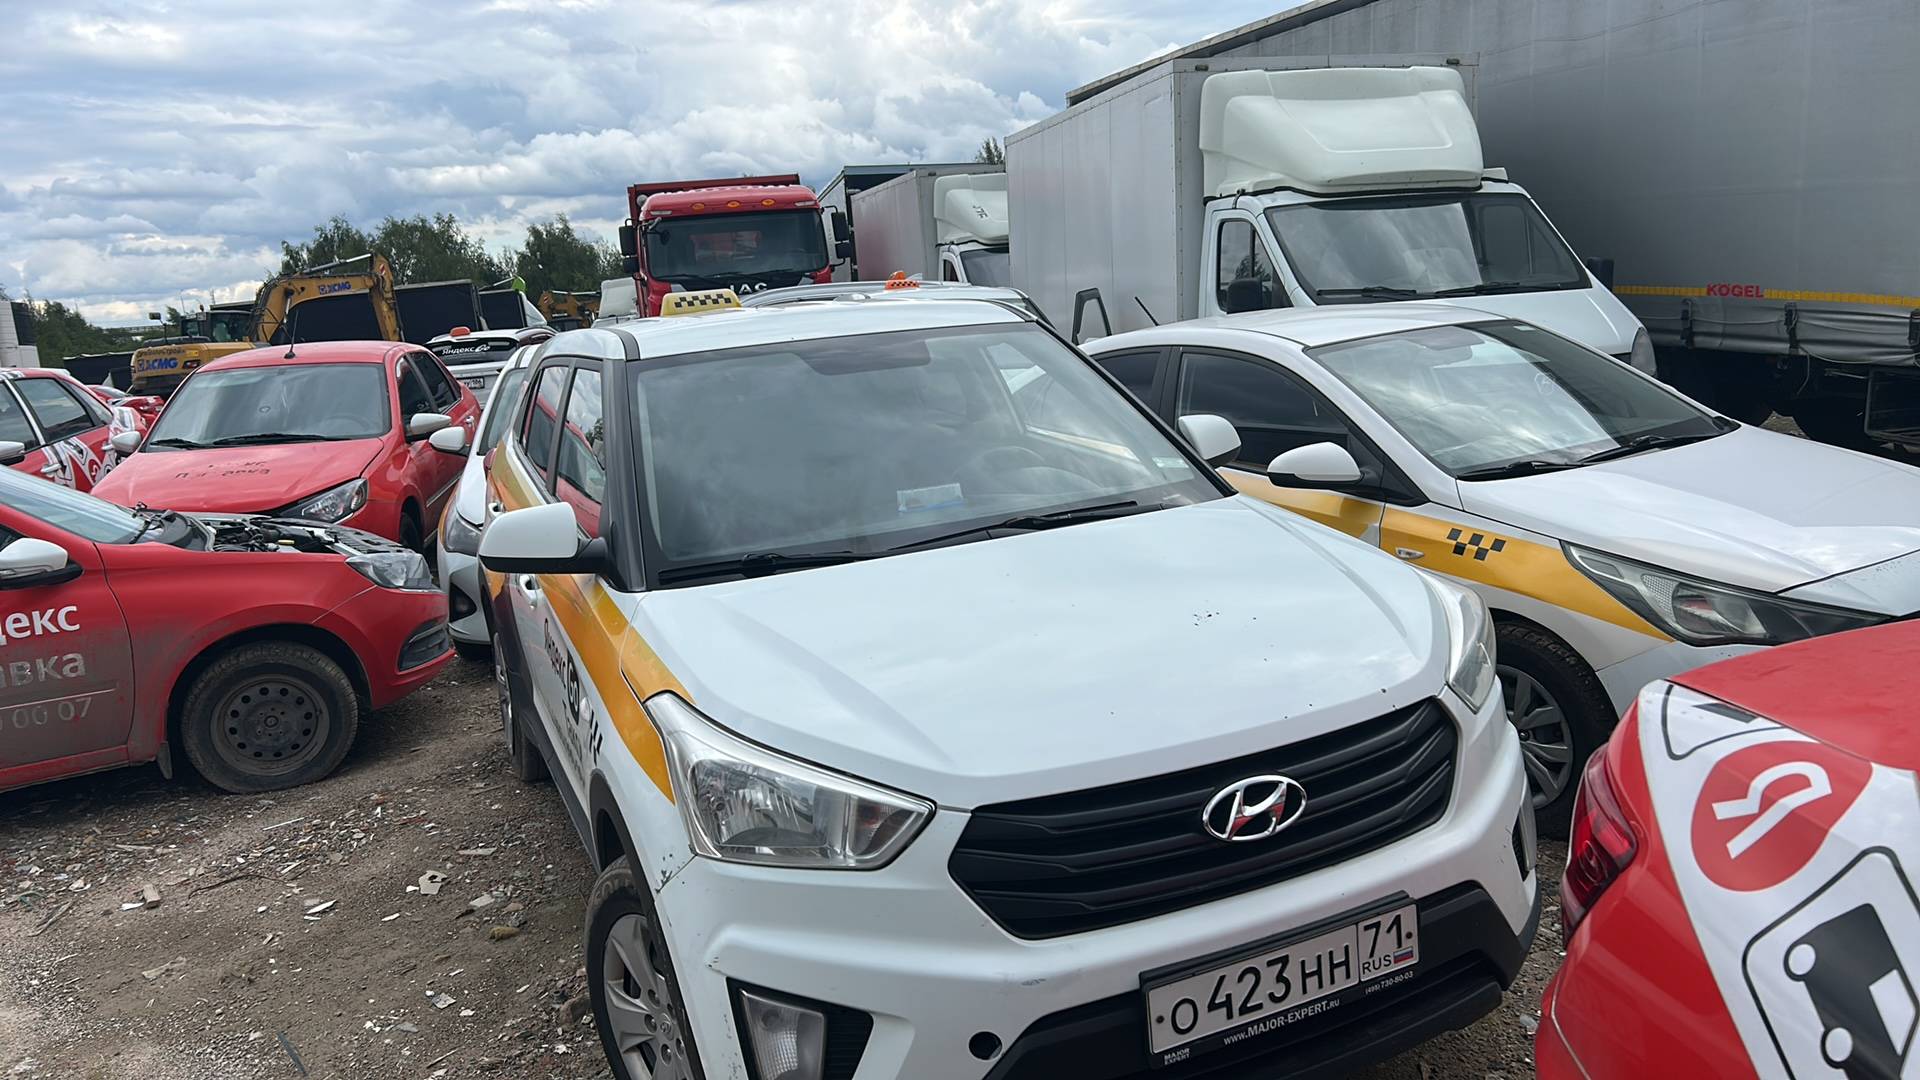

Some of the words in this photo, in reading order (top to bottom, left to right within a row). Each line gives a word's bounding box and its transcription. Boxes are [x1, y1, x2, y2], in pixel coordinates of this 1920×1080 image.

[442, 346, 475, 355] Яндекс
[0, 605, 80, 646] екс
[1361, 954, 1393, 975] RUS
